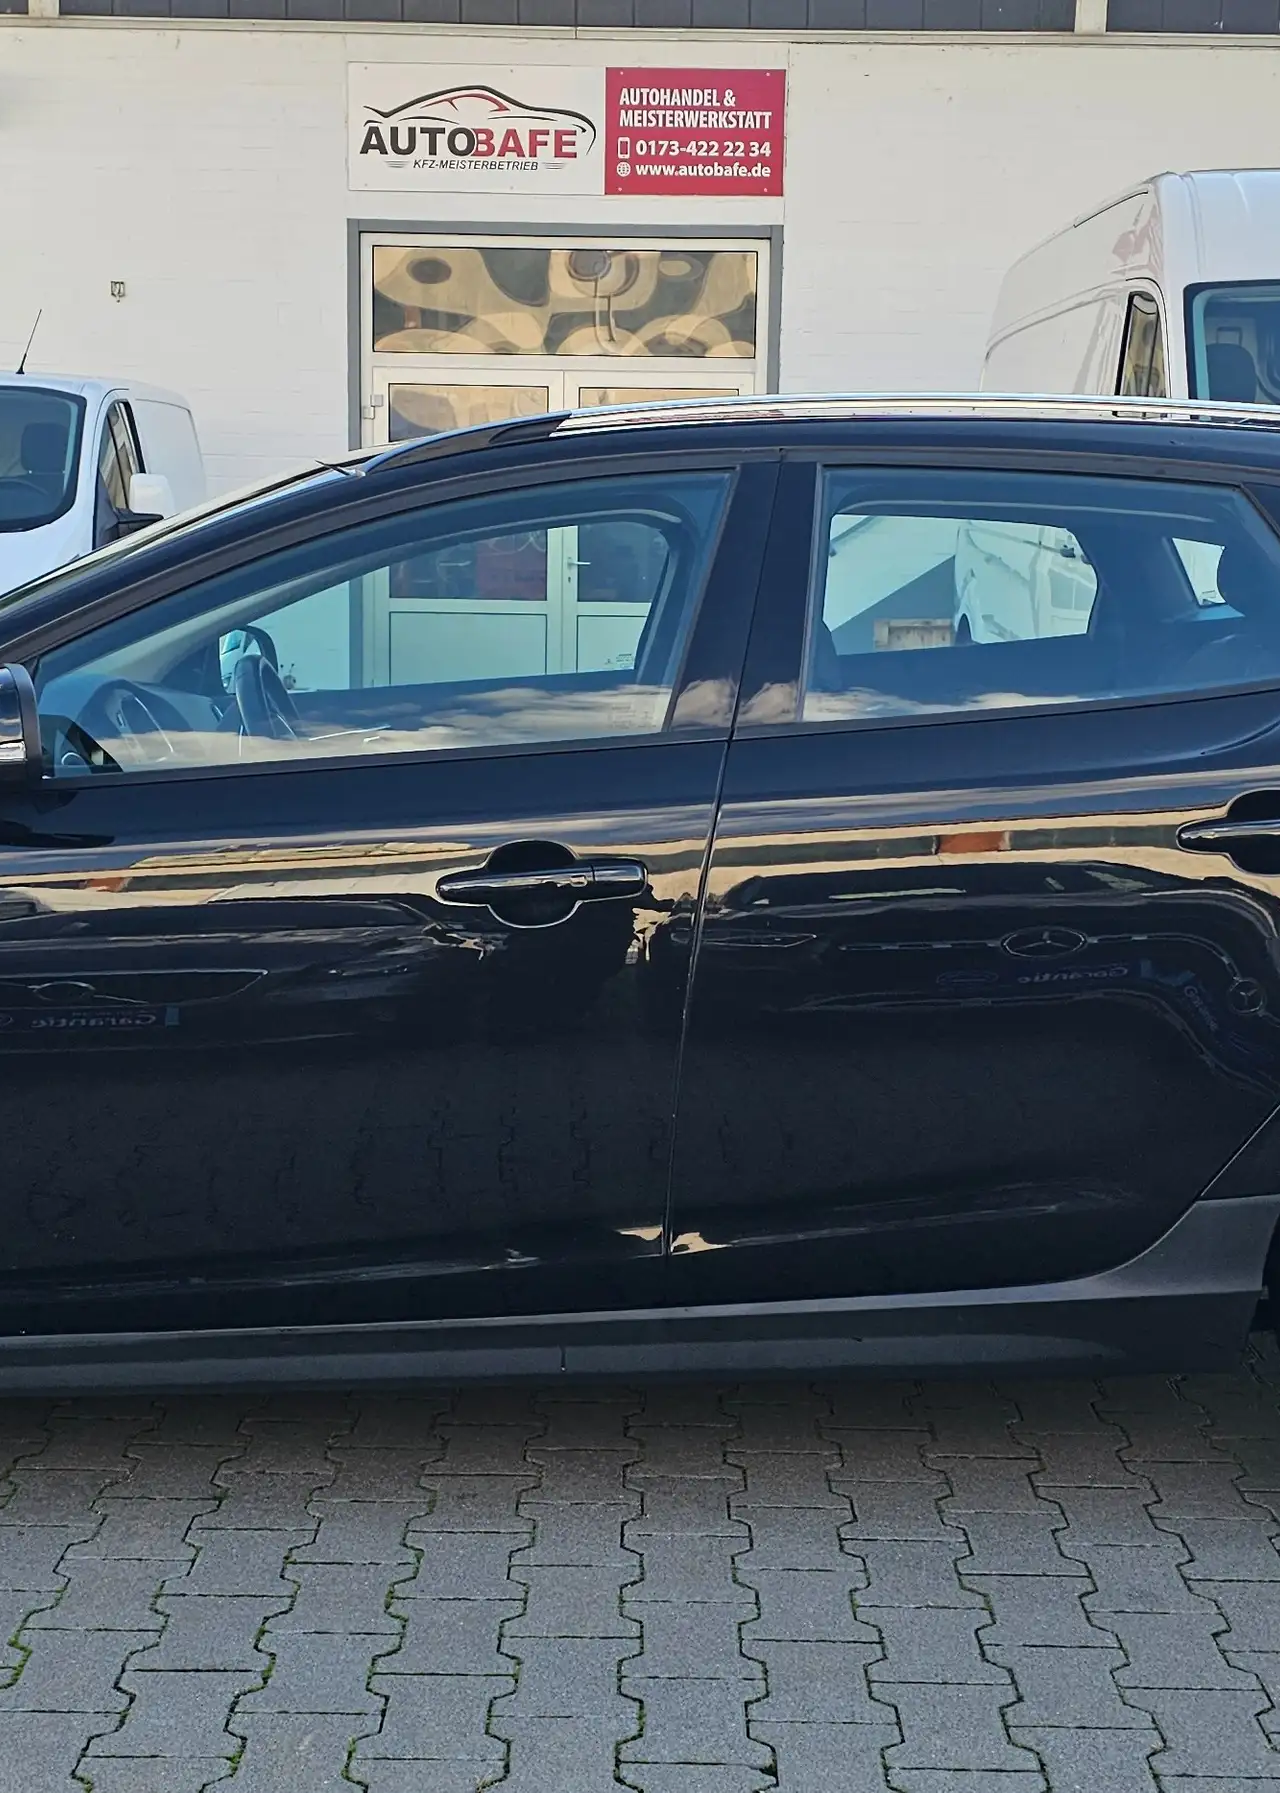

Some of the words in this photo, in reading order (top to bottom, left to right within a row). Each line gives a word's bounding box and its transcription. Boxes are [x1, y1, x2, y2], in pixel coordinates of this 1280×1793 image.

[620, 88, 721, 107] AUTOHANDEL
[723, 89, 736, 107] &
[620, 109, 772, 129] MEISTERWERKSTATT
[359, 126, 578, 158] AUTOBAFE
[635, 139, 719, 157] 0173-422
[723, 141, 742, 157] 22
[749, 141, 772, 157] 34
[413, 159, 539, 171] KFZ-MEISTERBETRIEB
[635, 161, 771, 178] www.autobafe.de
